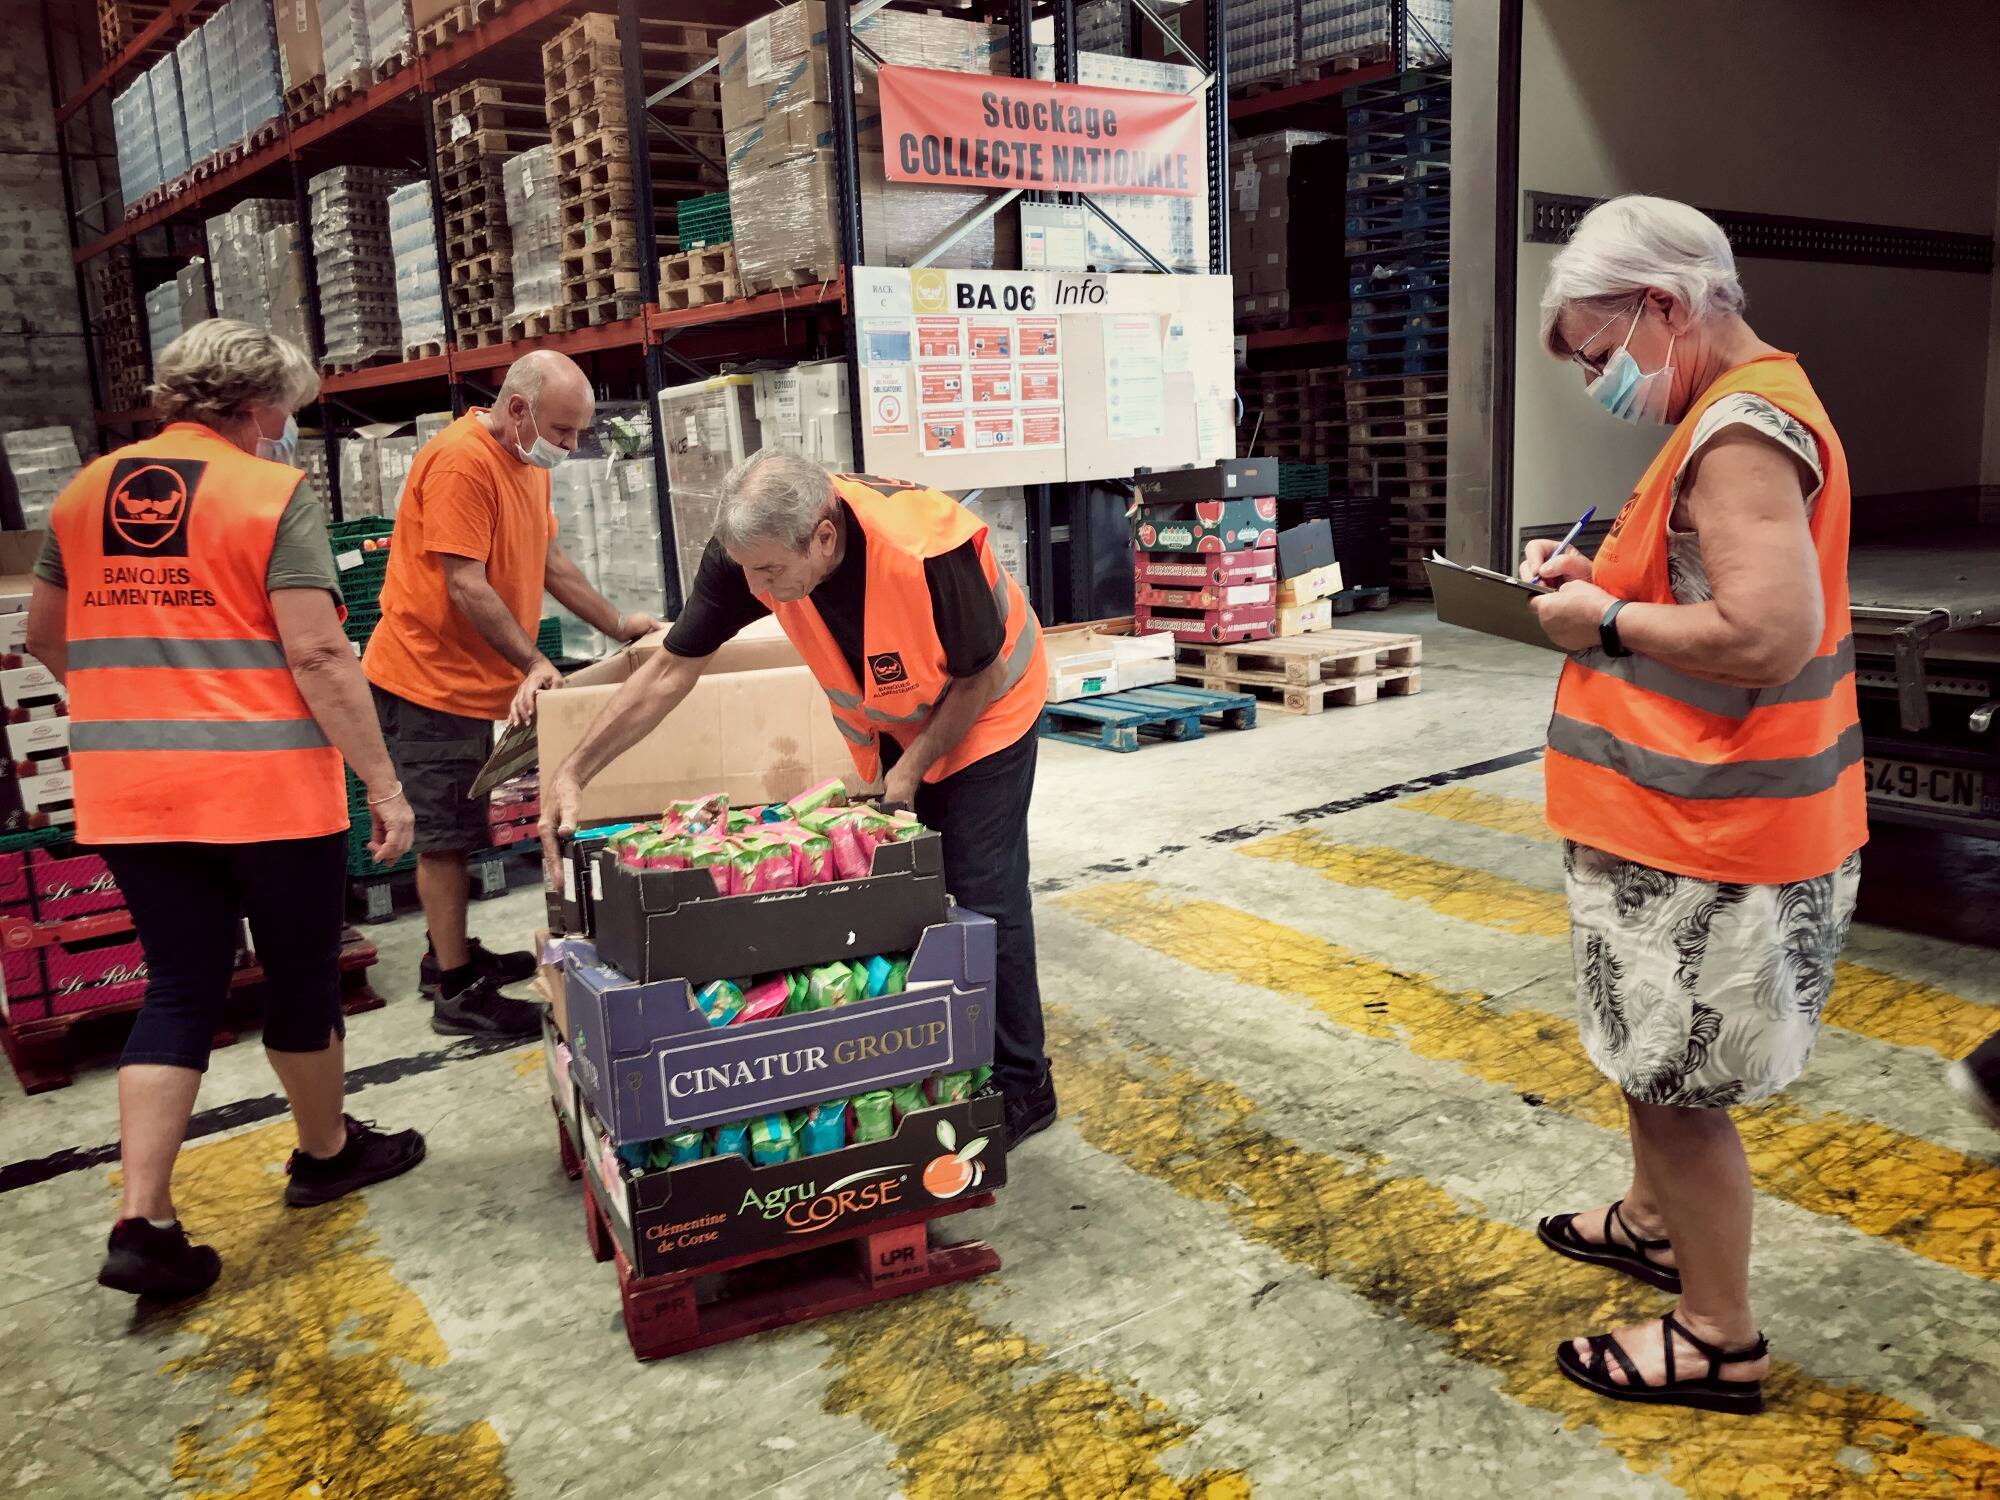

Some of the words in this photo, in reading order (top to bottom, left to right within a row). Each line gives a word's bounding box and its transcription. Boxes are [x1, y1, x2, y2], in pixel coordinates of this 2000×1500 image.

[981, 91, 1118, 139] Stockage
[898, 132, 1044, 182] COLLECTE
[1052, 145, 1189, 190] NATIONALE
[956, 283, 998, 310] BA
[1003, 285, 1036, 312] 06
[104, 567, 190, 585] BANQUES
[83, 589, 217, 607] ALIMENTAIRES
[879, 681, 910, 691] BANQUES
[668, 1046, 829, 1097] CINATUR
[833, 1021, 946, 1065] GROUP
[737, 1181, 815, 1220] Agru
[784, 1179, 902, 1227] CORSE
[646, 1212, 728, 1241] Clémentine
[657, 1240, 675, 1254] de
[677, 1231, 719, 1249] Corse
[880, 1246, 915, 1266] LPR
